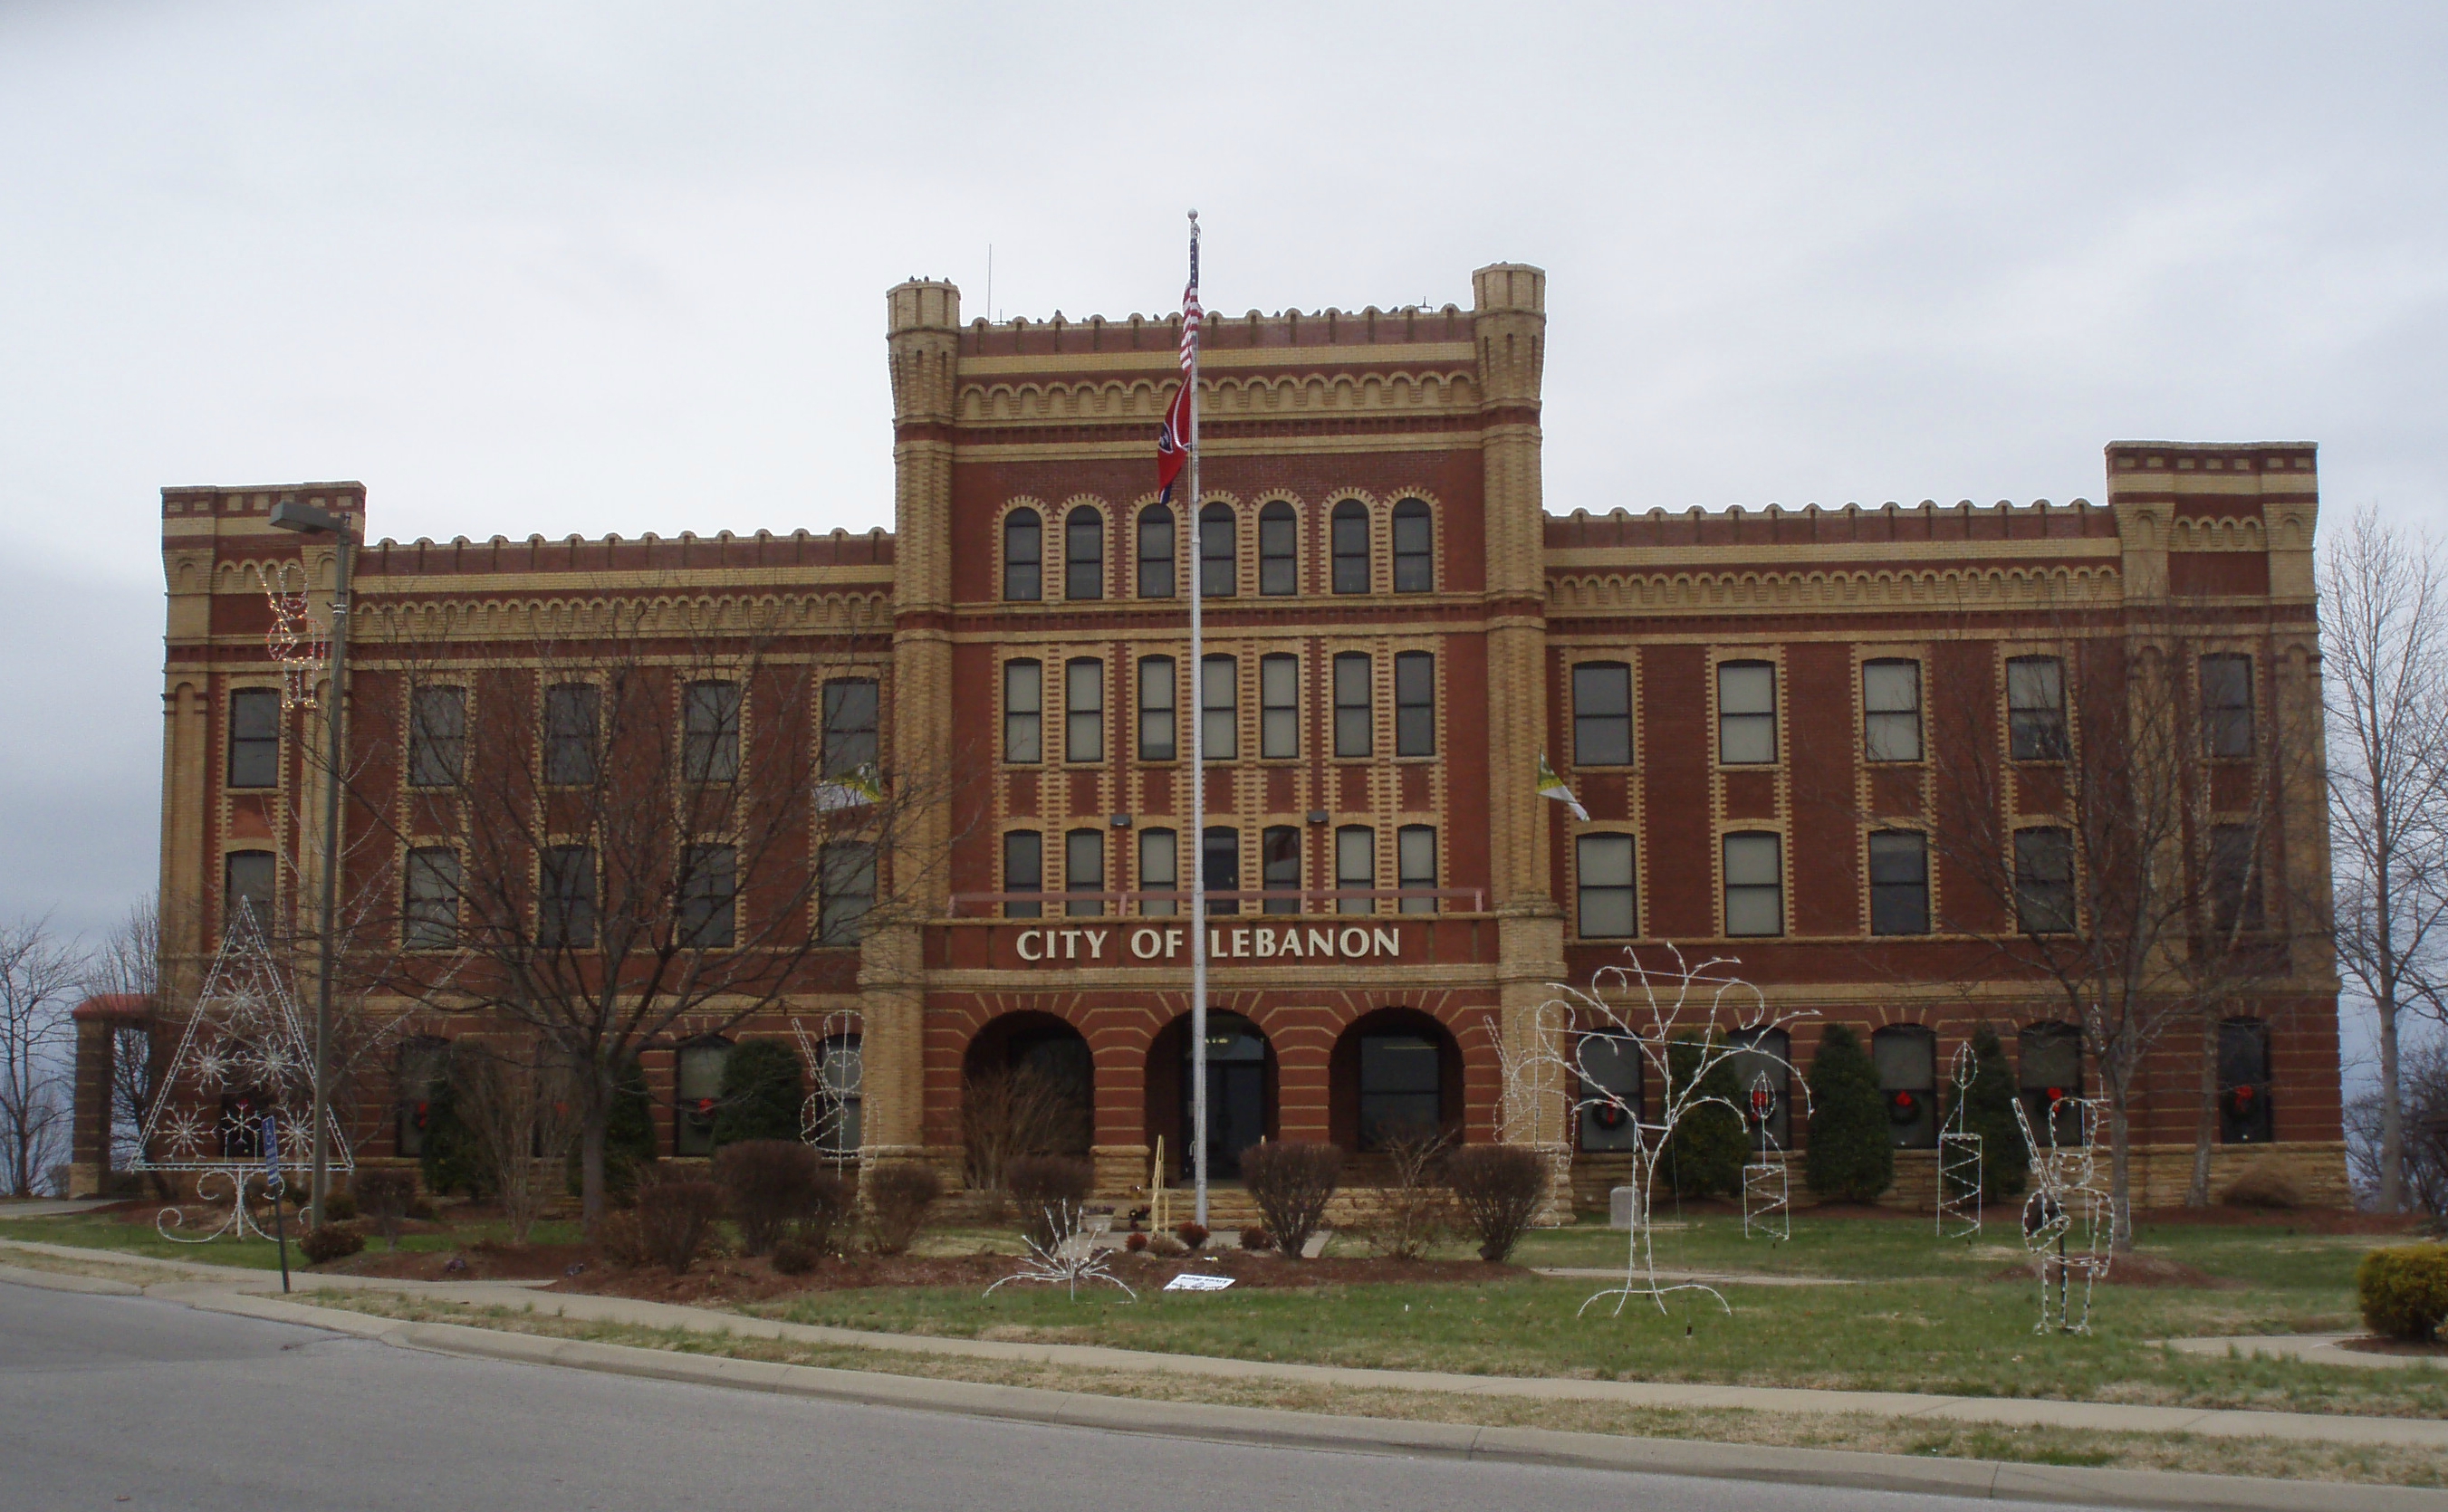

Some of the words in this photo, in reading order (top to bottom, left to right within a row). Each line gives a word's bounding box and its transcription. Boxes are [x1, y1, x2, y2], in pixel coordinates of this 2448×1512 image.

[1016, 930, 1109, 961] CITY
[1131, 929, 1183, 959] OF
[1210, 927, 1399, 958] LEBANON
